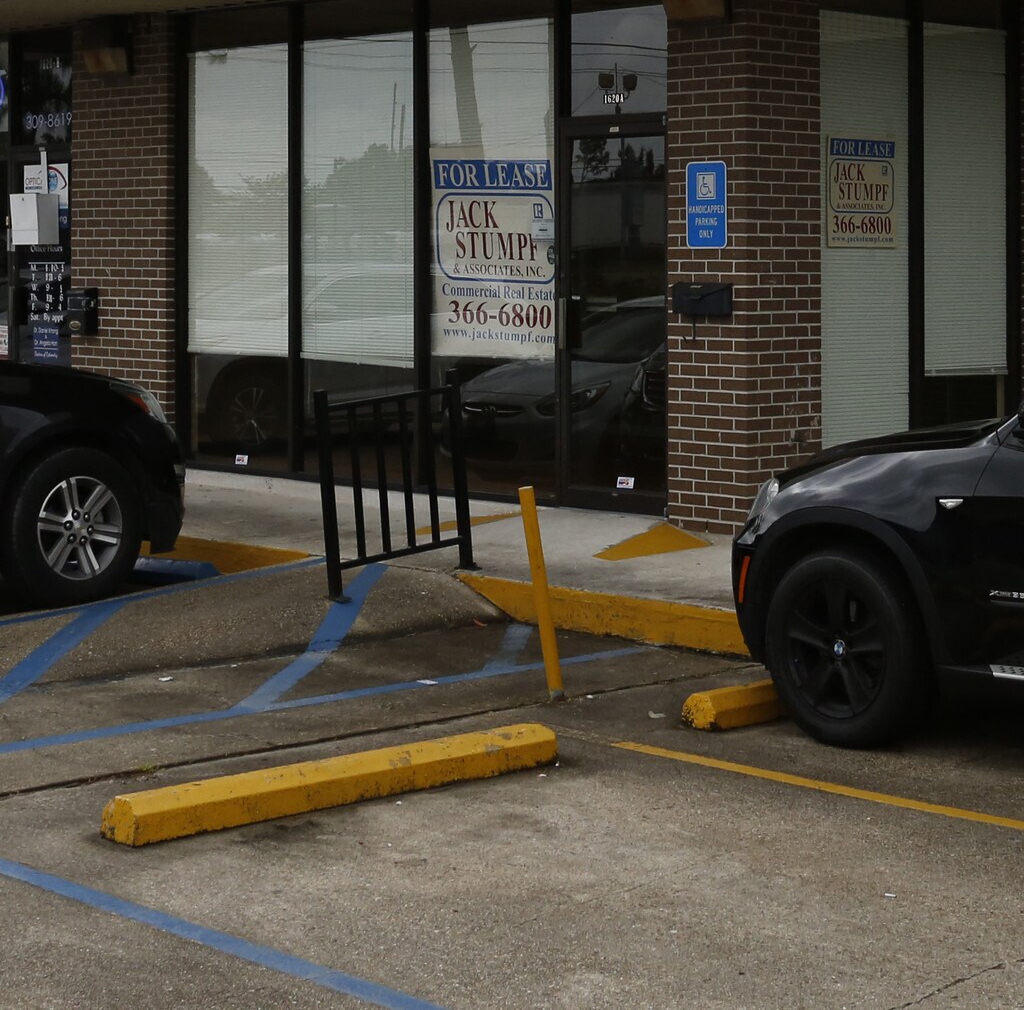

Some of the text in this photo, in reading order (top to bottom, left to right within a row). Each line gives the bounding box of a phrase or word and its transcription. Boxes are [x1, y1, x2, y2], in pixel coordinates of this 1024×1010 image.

[604, 93, 624, 104] 1620A
[26, 112, 72, 129] 309-8619
[833, 140, 892, 157] FOR LEASE
[438, 163, 549, 188] FOR LEASE
[834, 162, 865, 183] JACK
[25, 177, 43, 186] OPTIC
[838, 182, 889, 202] STUMPF
[446, 200, 499, 232] JACK
[688, 204, 725, 214] HANDICAPPED
[695, 217, 718, 226] PARKING
[832, 214, 892, 235] 366-6800
[698, 230, 714, 239] ONLY
[832, 236, 894, 244] www.jackstumpf.com
[456, 231, 538, 262] STUMPF
[453, 263, 546, 278] & ASSOCIATES, INC.
[442, 282, 501, 299] Commercial
[503, 285, 525, 300] Real
[43, 312, 51, 323] By
[448, 300, 552, 329] 366-6800
[443, 328, 555, 345] www.jackstumpf.com
